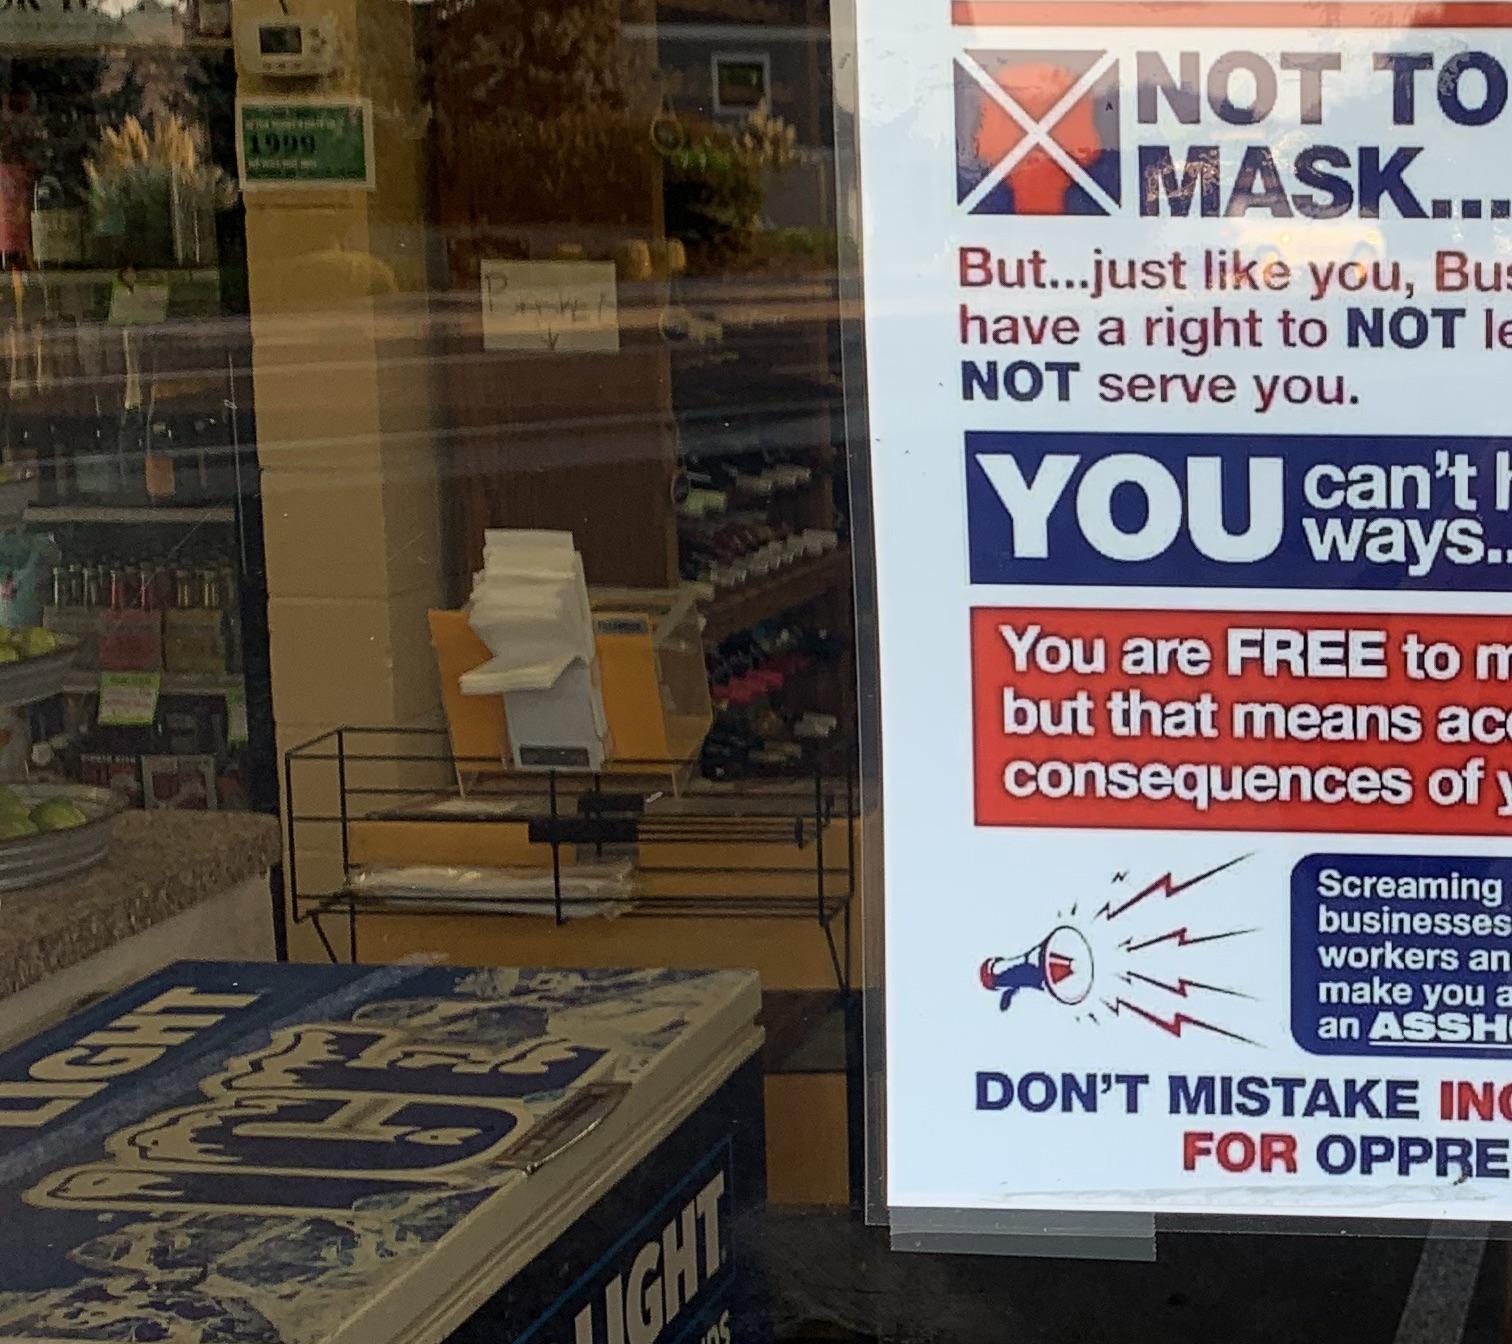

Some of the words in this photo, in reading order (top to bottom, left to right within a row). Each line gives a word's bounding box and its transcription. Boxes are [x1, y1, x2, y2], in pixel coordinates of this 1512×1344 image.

[1134, 49, 1342, 126] NOT
[1372, 49, 1509, 126] TO
[1138, 145, 1511, 221] MASK...
[957, 247, 1188, 297] But...just
[1204, 248, 1290, 293] like
[1307, 255, 1417, 302] you,
[958, 307, 1082, 347] have
[1098, 317, 1128, 348] a
[1146, 308, 1264, 361] right
[1280, 310, 1327, 349] to
[1346, 307, 1468, 350] NOT
[961, 360, 1081, 403] NOT
[1097, 373, 1238, 405] serve
[1254, 373, 1360, 415] you.
[977, 454, 1284, 561] YOU
[1303, 450, 1477, 510] can't
[1000, 626, 1105, 673] You
[1123, 638, 1211, 676] are
[1227, 630, 1387, 679] FREE
[1402, 634, 1461, 681] to
[1003, 688, 1095, 735] but
[1107, 689, 1219, 737] that
[1233, 701, 1421, 743] means
[1003, 759, 1412, 808] consequences
[1428, 761, 1483, 805] of
[1318, 870, 1502, 907] Screaming
[1319, 907, 1511, 939] businesses
[1318, 943, 1457, 973] workers
[1319, 977, 1409, 1008] make
[1422, 984, 1484, 1016] you
[1318, 1018, 1359, 1040] an
[975, 1071, 1148, 1117] DON'T
[1169, 1075, 1420, 1122] MISTAKE
[1183, 1132, 1297, 1173] FOR
